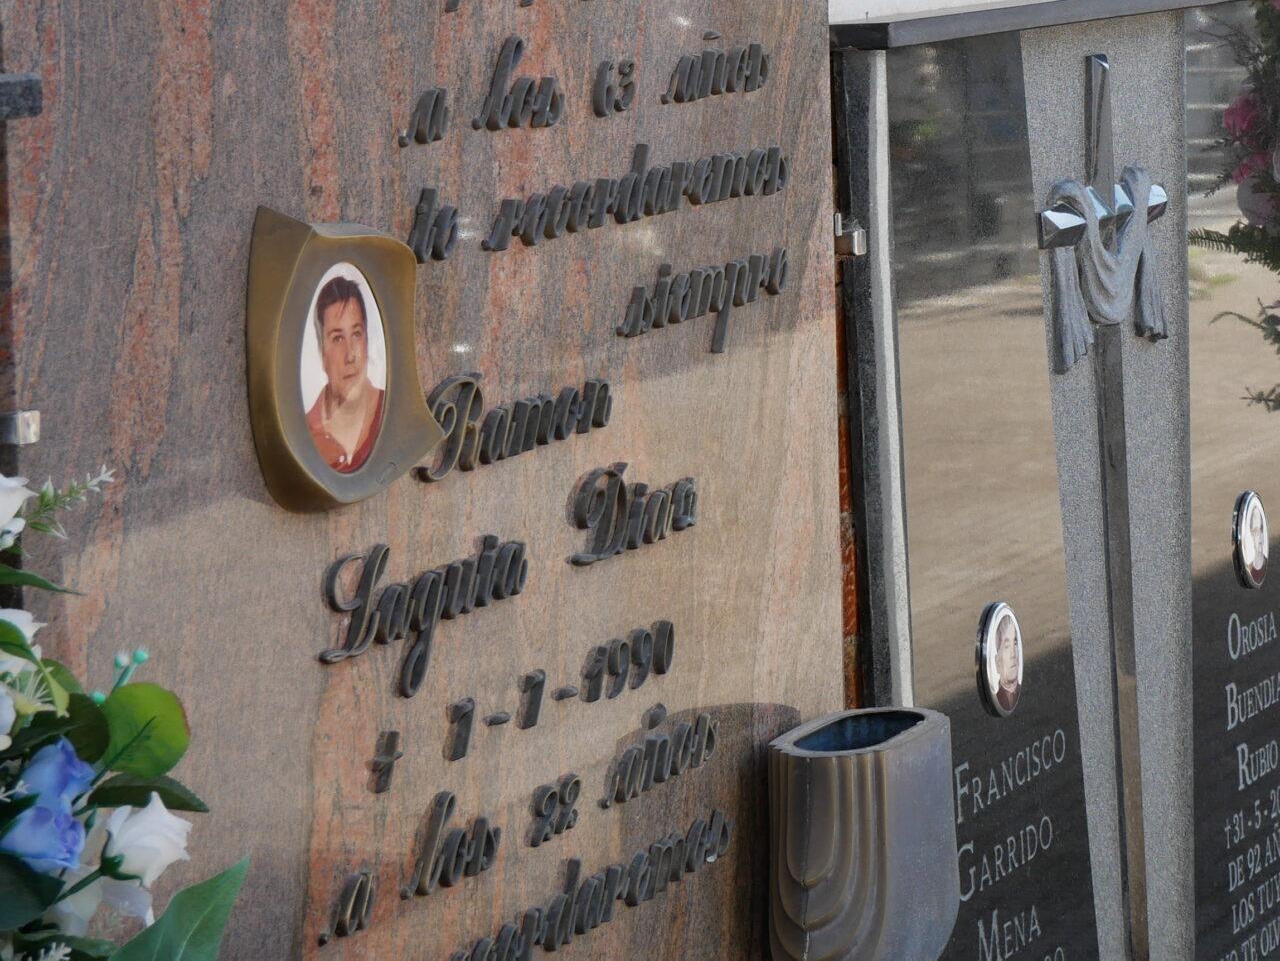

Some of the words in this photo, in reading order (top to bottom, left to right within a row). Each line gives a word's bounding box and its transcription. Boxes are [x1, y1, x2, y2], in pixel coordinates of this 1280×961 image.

[398, 85, 449, 148] a
[471, 34, 566, 132] los
[660, 30, 770, 105] años
[408, 187, 459, 264] te
[481, 143, 791, 252] recordaremos
[616, 246, 788, 354] siempre
[409, 372, 613, 483] Ramon
[567, 461, 698, 566] Diaz
[1227, 611, 1278, 661] OROSIA
[954, 728, 1066, 825] FRANCISCO
[1236, 739, 1279, 791] RUBIO
[317, 869, 375, 947] a
[400, 790, 501, 901] los
[598, 701, 720, 809] años
[957, 815, 1054, 902] GARRIDO
[1228, 854, 1245, 892] DE
[1247, 843, 1262, 881] 92
[977, 904, 1042, 961] MENA
[1231, 892, 1255, 935] LOS
